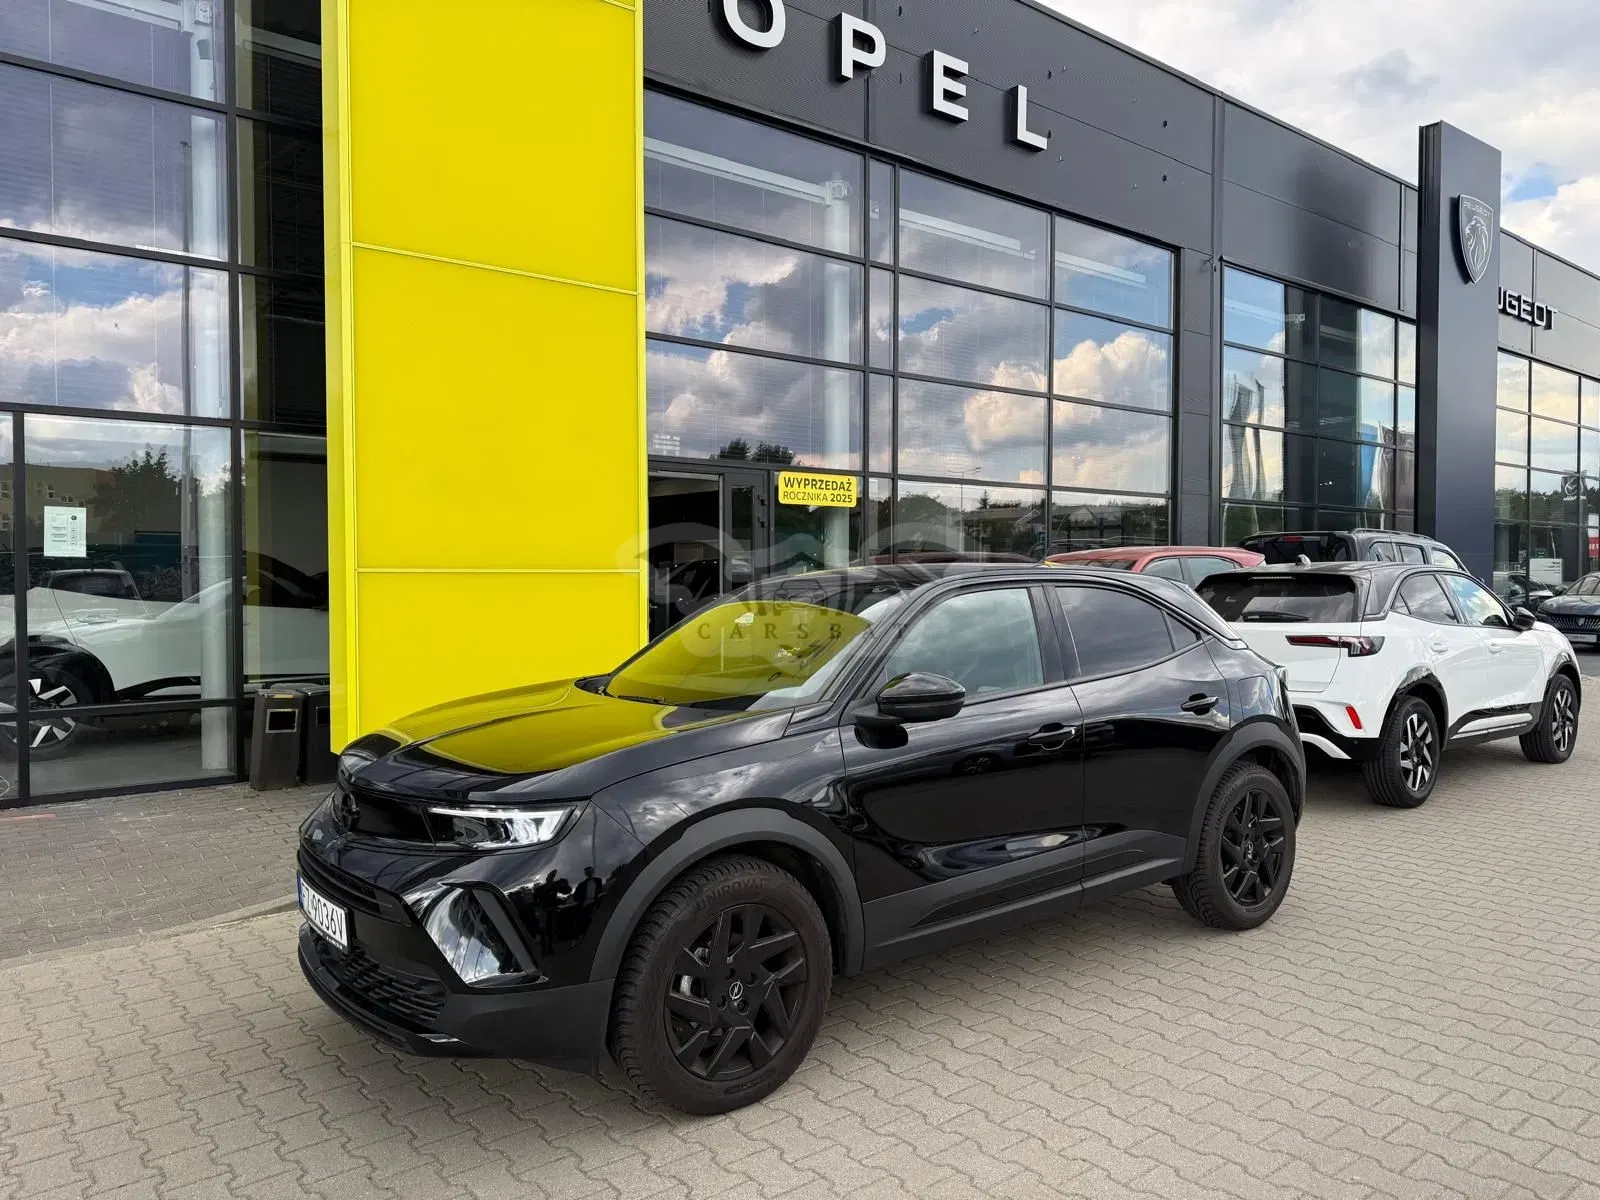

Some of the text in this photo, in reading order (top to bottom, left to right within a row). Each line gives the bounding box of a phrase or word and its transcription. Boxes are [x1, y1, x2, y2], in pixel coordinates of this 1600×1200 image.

[723, 0, 1048, 151] OPEL
[1463, 200, 1491, 217] PEUGEOT
[783, 476, 852, 492] WYPRZEDAŻ
[783, 490, 853, 503] ROCZNIKA 2025
